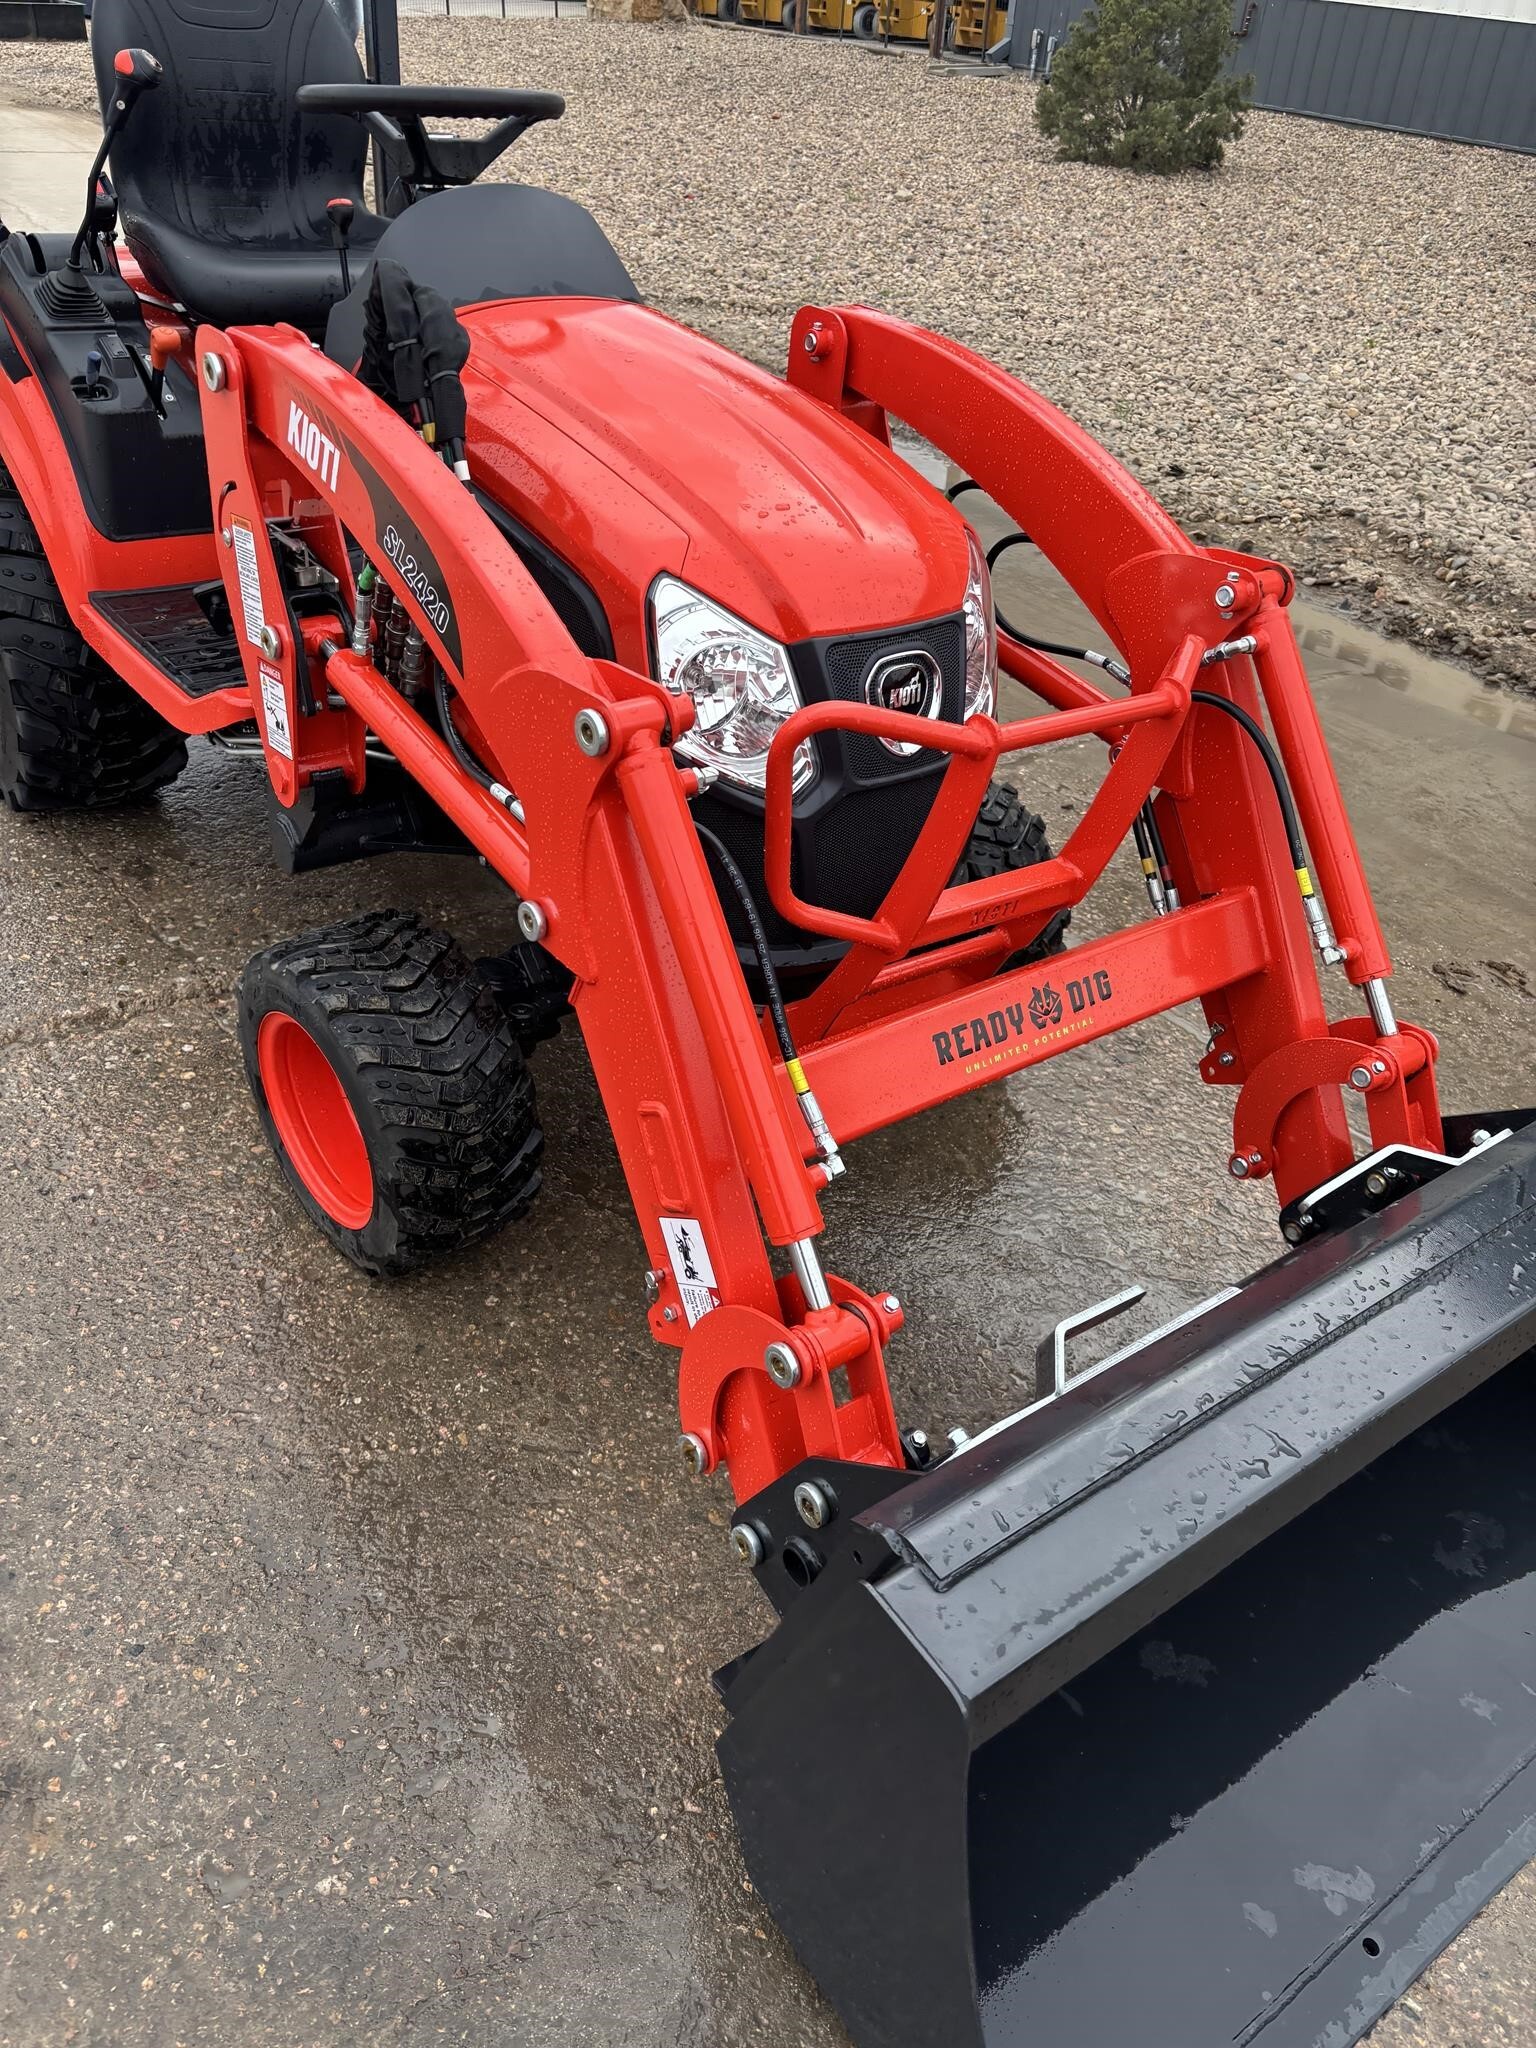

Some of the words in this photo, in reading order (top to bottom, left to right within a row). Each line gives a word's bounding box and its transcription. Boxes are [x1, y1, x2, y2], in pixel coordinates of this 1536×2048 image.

[287, 399, 341, 493] KIOTI
[383, 524, 450, 634] SL2420
[889, 676, 922, 709] KIOTI
[761, 958, 775, 985] KOREA
[769, 987, 778, 998] IN
[772, 1002, 785, 1025] MADE
[931, 1002, 1025, 1066] READY
[1065, 969, 1113, 1014] DIG
[964, 1042, 1029, 1074] UNLIMITED
[1034, 1016, 1095, 1047] POTENTIAL
